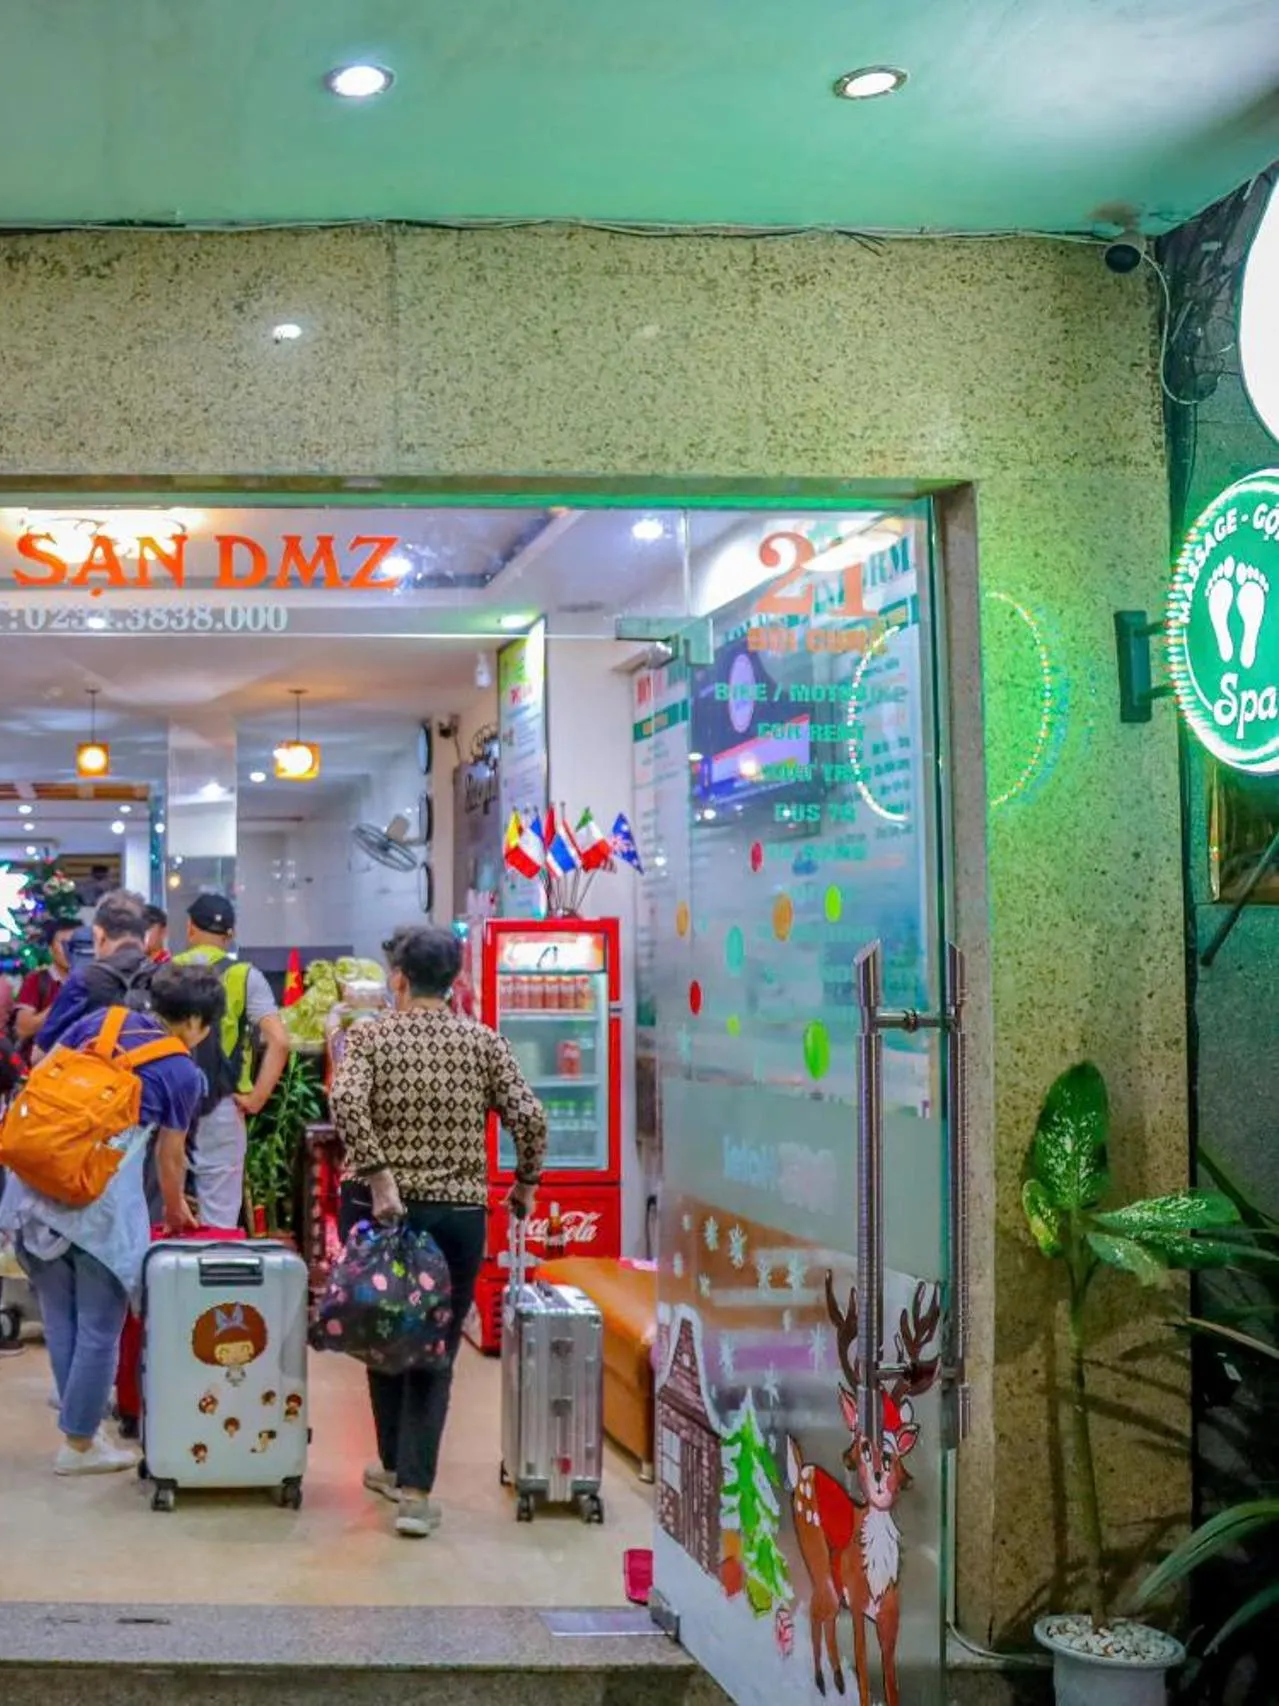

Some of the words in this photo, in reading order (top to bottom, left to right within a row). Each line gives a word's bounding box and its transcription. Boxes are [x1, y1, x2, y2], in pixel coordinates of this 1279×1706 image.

[14, 534, 189, 597] SẠN
[215, 535, 404, 589] DMZ
[755, 531, 878, 617] 21
[1214, 672, 1277, 739] Spa
